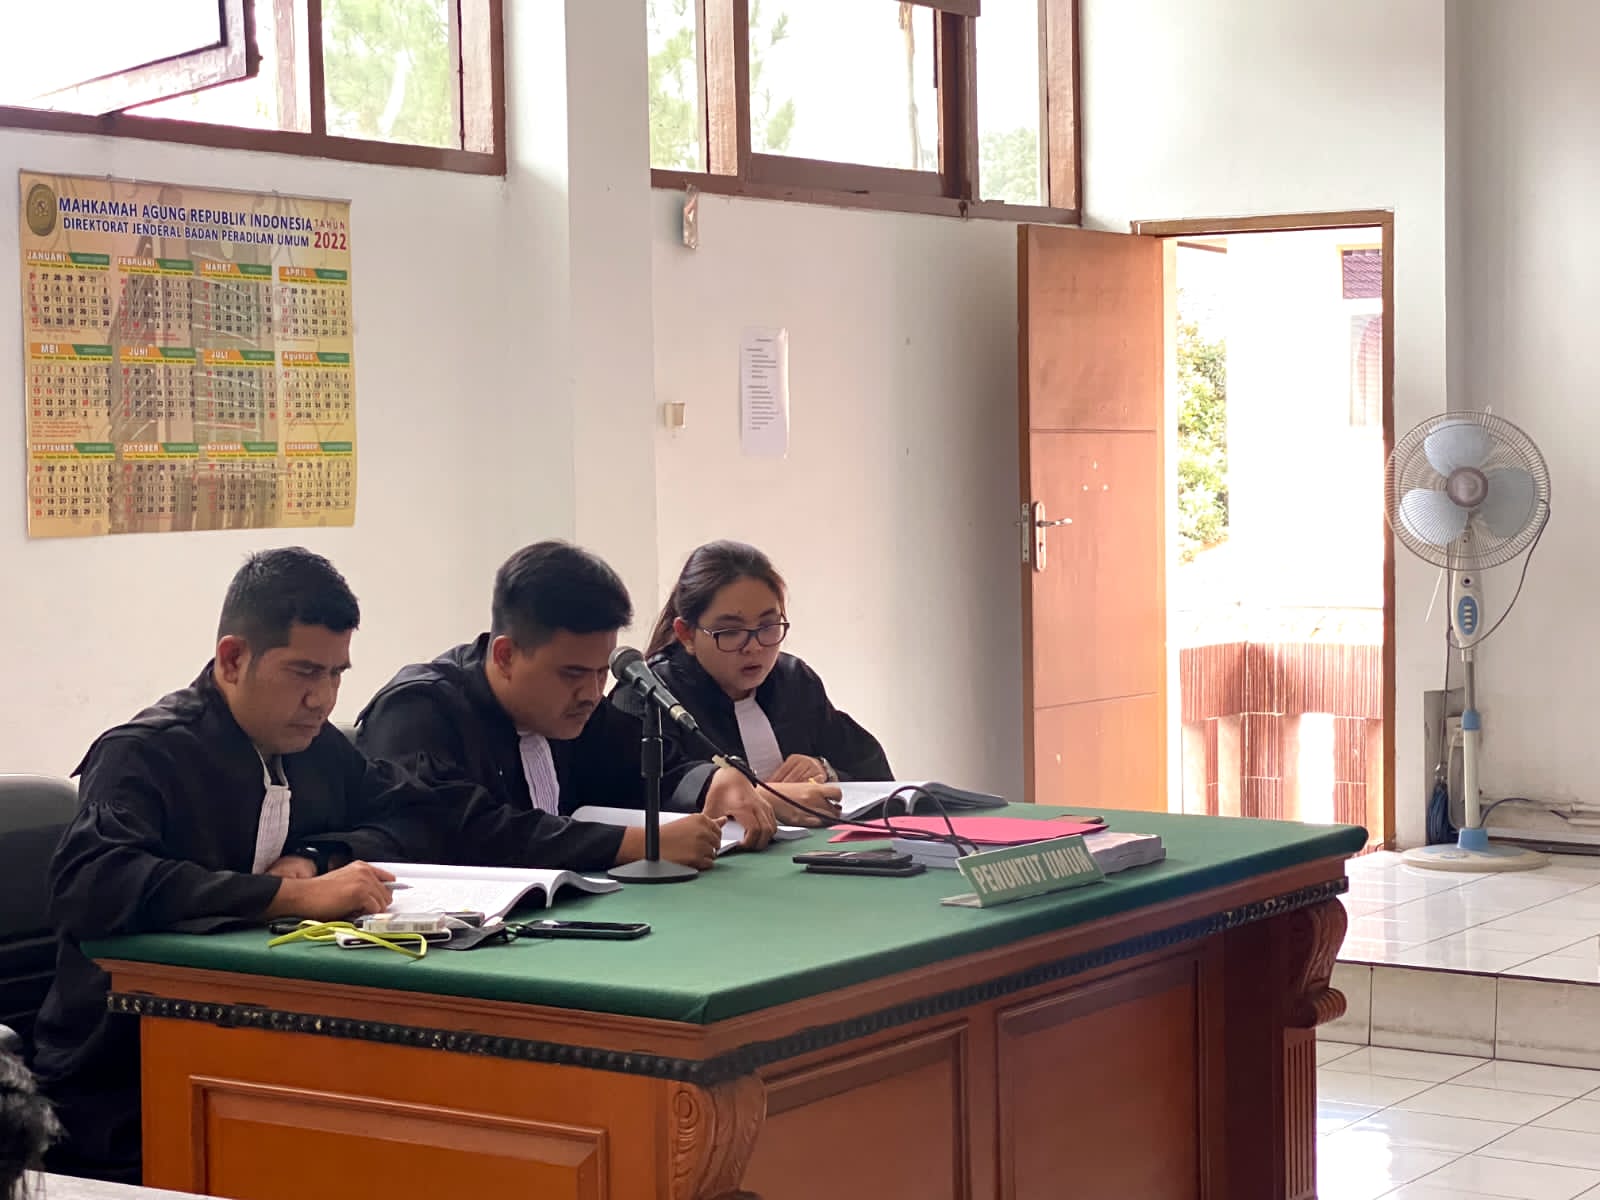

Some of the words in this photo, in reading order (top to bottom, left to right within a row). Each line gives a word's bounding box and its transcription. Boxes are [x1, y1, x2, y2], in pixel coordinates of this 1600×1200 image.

[59, 198, 137, 217] MAHKAMAH
[142, 205, 186, 221] AGUNG
[190, 208, 246, 226] REPUBLIK
[250, 214, 313, 231] INDONESIA
[314, 218, 345, 230] TAHUN
[63, 217, 128, 233] DIREKTORAT
[132, 223, 181, 238] JENDERAL
[185, 227, 219, 240] BADAN
[222, 230, 274, 244] PERADILAN
[277, 235, 309, 247] UMUM
[314, 232, 347, 250] 2022
[26, 250, 66, 262] JANUARI
[118, 257, 154, 267] FEBRUARI
[206, 263, 231, 272] MARET
[285, 267, 306, 277] APRIL
[41, 344, 58, 353] MEI
[129, 347, 148, 356] JUNI
[212, 351, 229, 360] JULI
[32, 444, 74, 452] SEPTEMBER
[124, 444, 158, 452] OKTOBER
[971, 854, 1047, 894] PENUNTUT
[1042, 846, 1094, 880] UMUM
